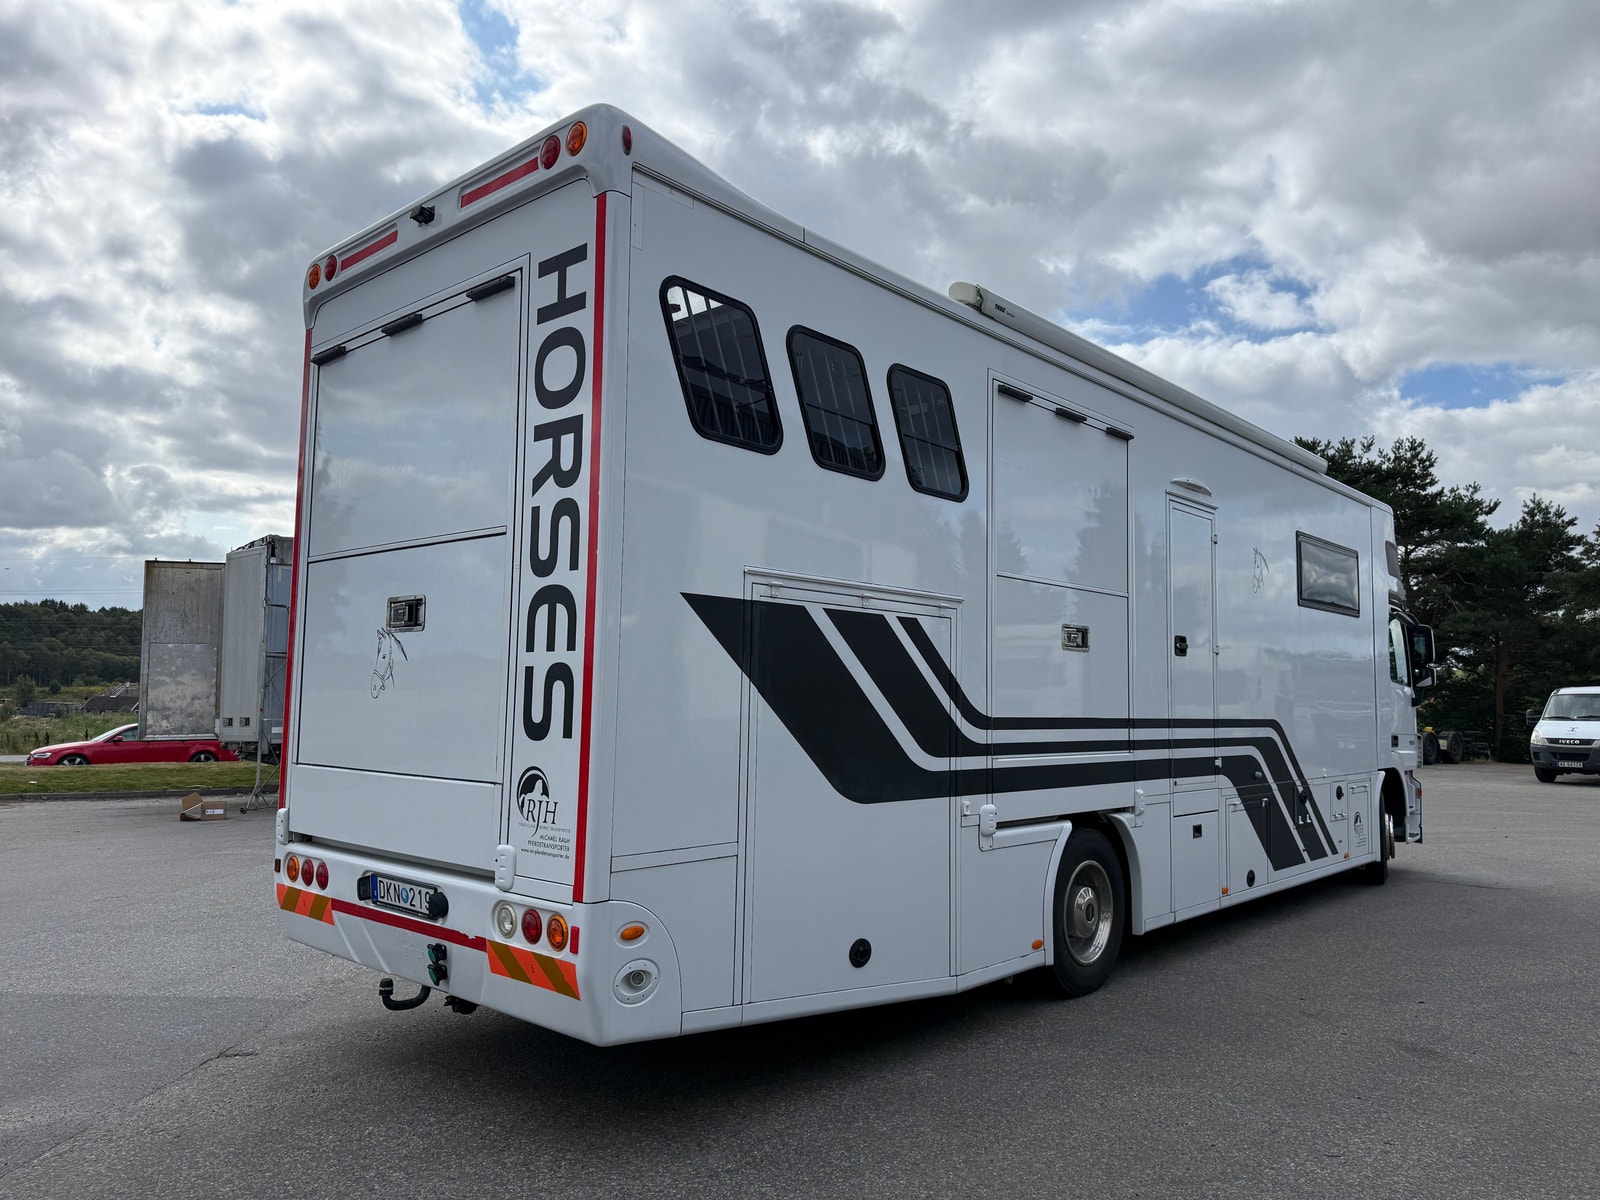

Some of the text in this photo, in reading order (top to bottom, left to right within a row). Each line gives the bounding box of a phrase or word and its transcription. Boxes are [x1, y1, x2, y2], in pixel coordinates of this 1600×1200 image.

[522, 242, 588, 742] HORSES
[527, 840, 570, 852] PFERDETRANSPORTER
[540, 834, 557, 843] MICHAEL
[379, 879, 401, 904] DKN
